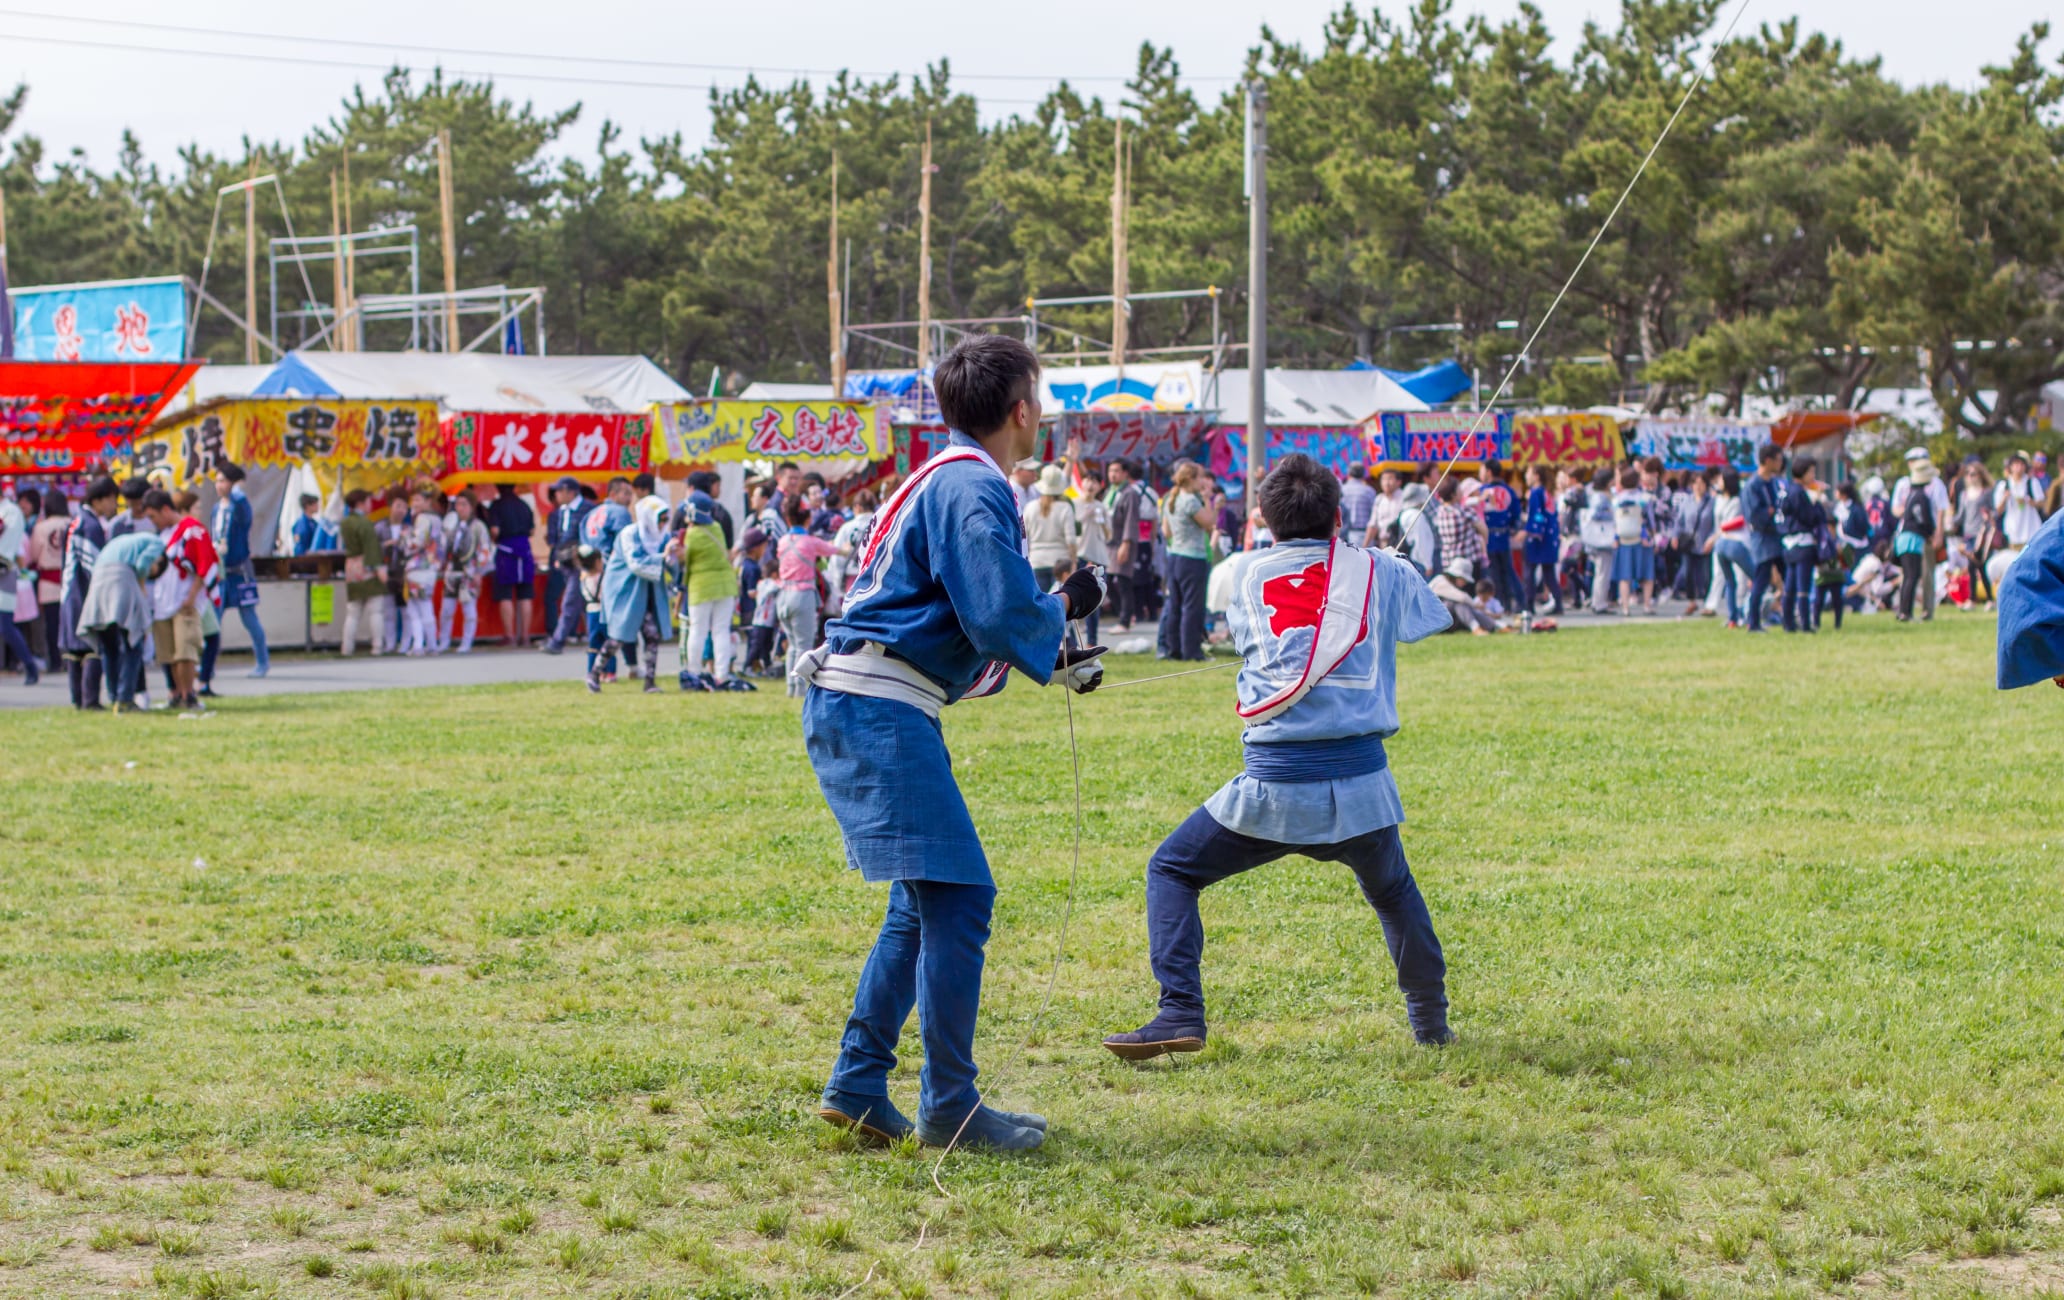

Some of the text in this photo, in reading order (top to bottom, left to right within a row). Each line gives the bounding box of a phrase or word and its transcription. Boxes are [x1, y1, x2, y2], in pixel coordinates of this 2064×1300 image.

[284, 406, 418, 461] 串焼
[488, 421, 609, 468] 水あめ
[620, 418, 646, 468] 特製
[747, 406, 867, 455] 広島焼
